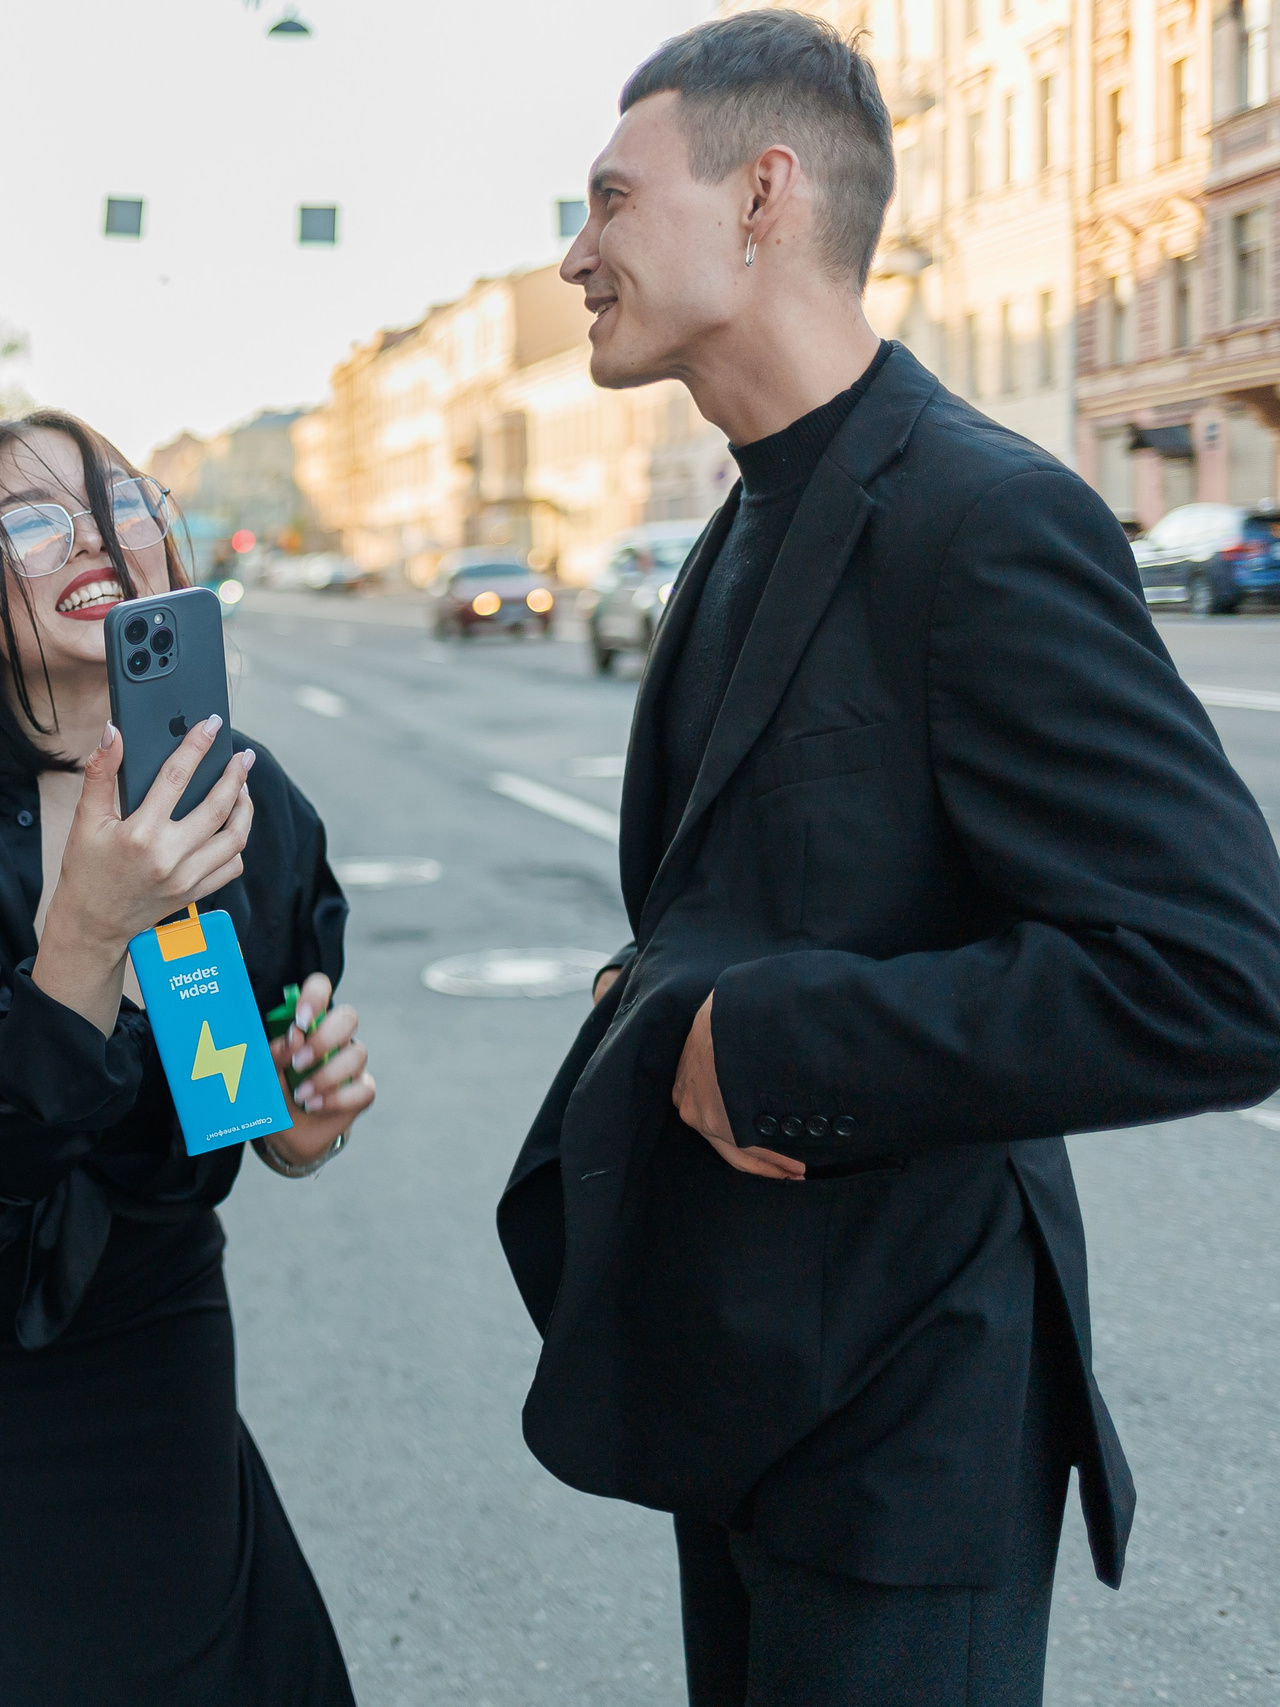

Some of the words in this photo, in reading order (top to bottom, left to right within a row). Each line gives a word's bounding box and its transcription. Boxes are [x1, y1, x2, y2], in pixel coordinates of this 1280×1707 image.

[169, 966, 219, 991] заряд!
[179, 980, 220, 1000] Бери
[241, 1116, 273, 1130] Садится
[206, 1126, 241, 1141] телефон?
